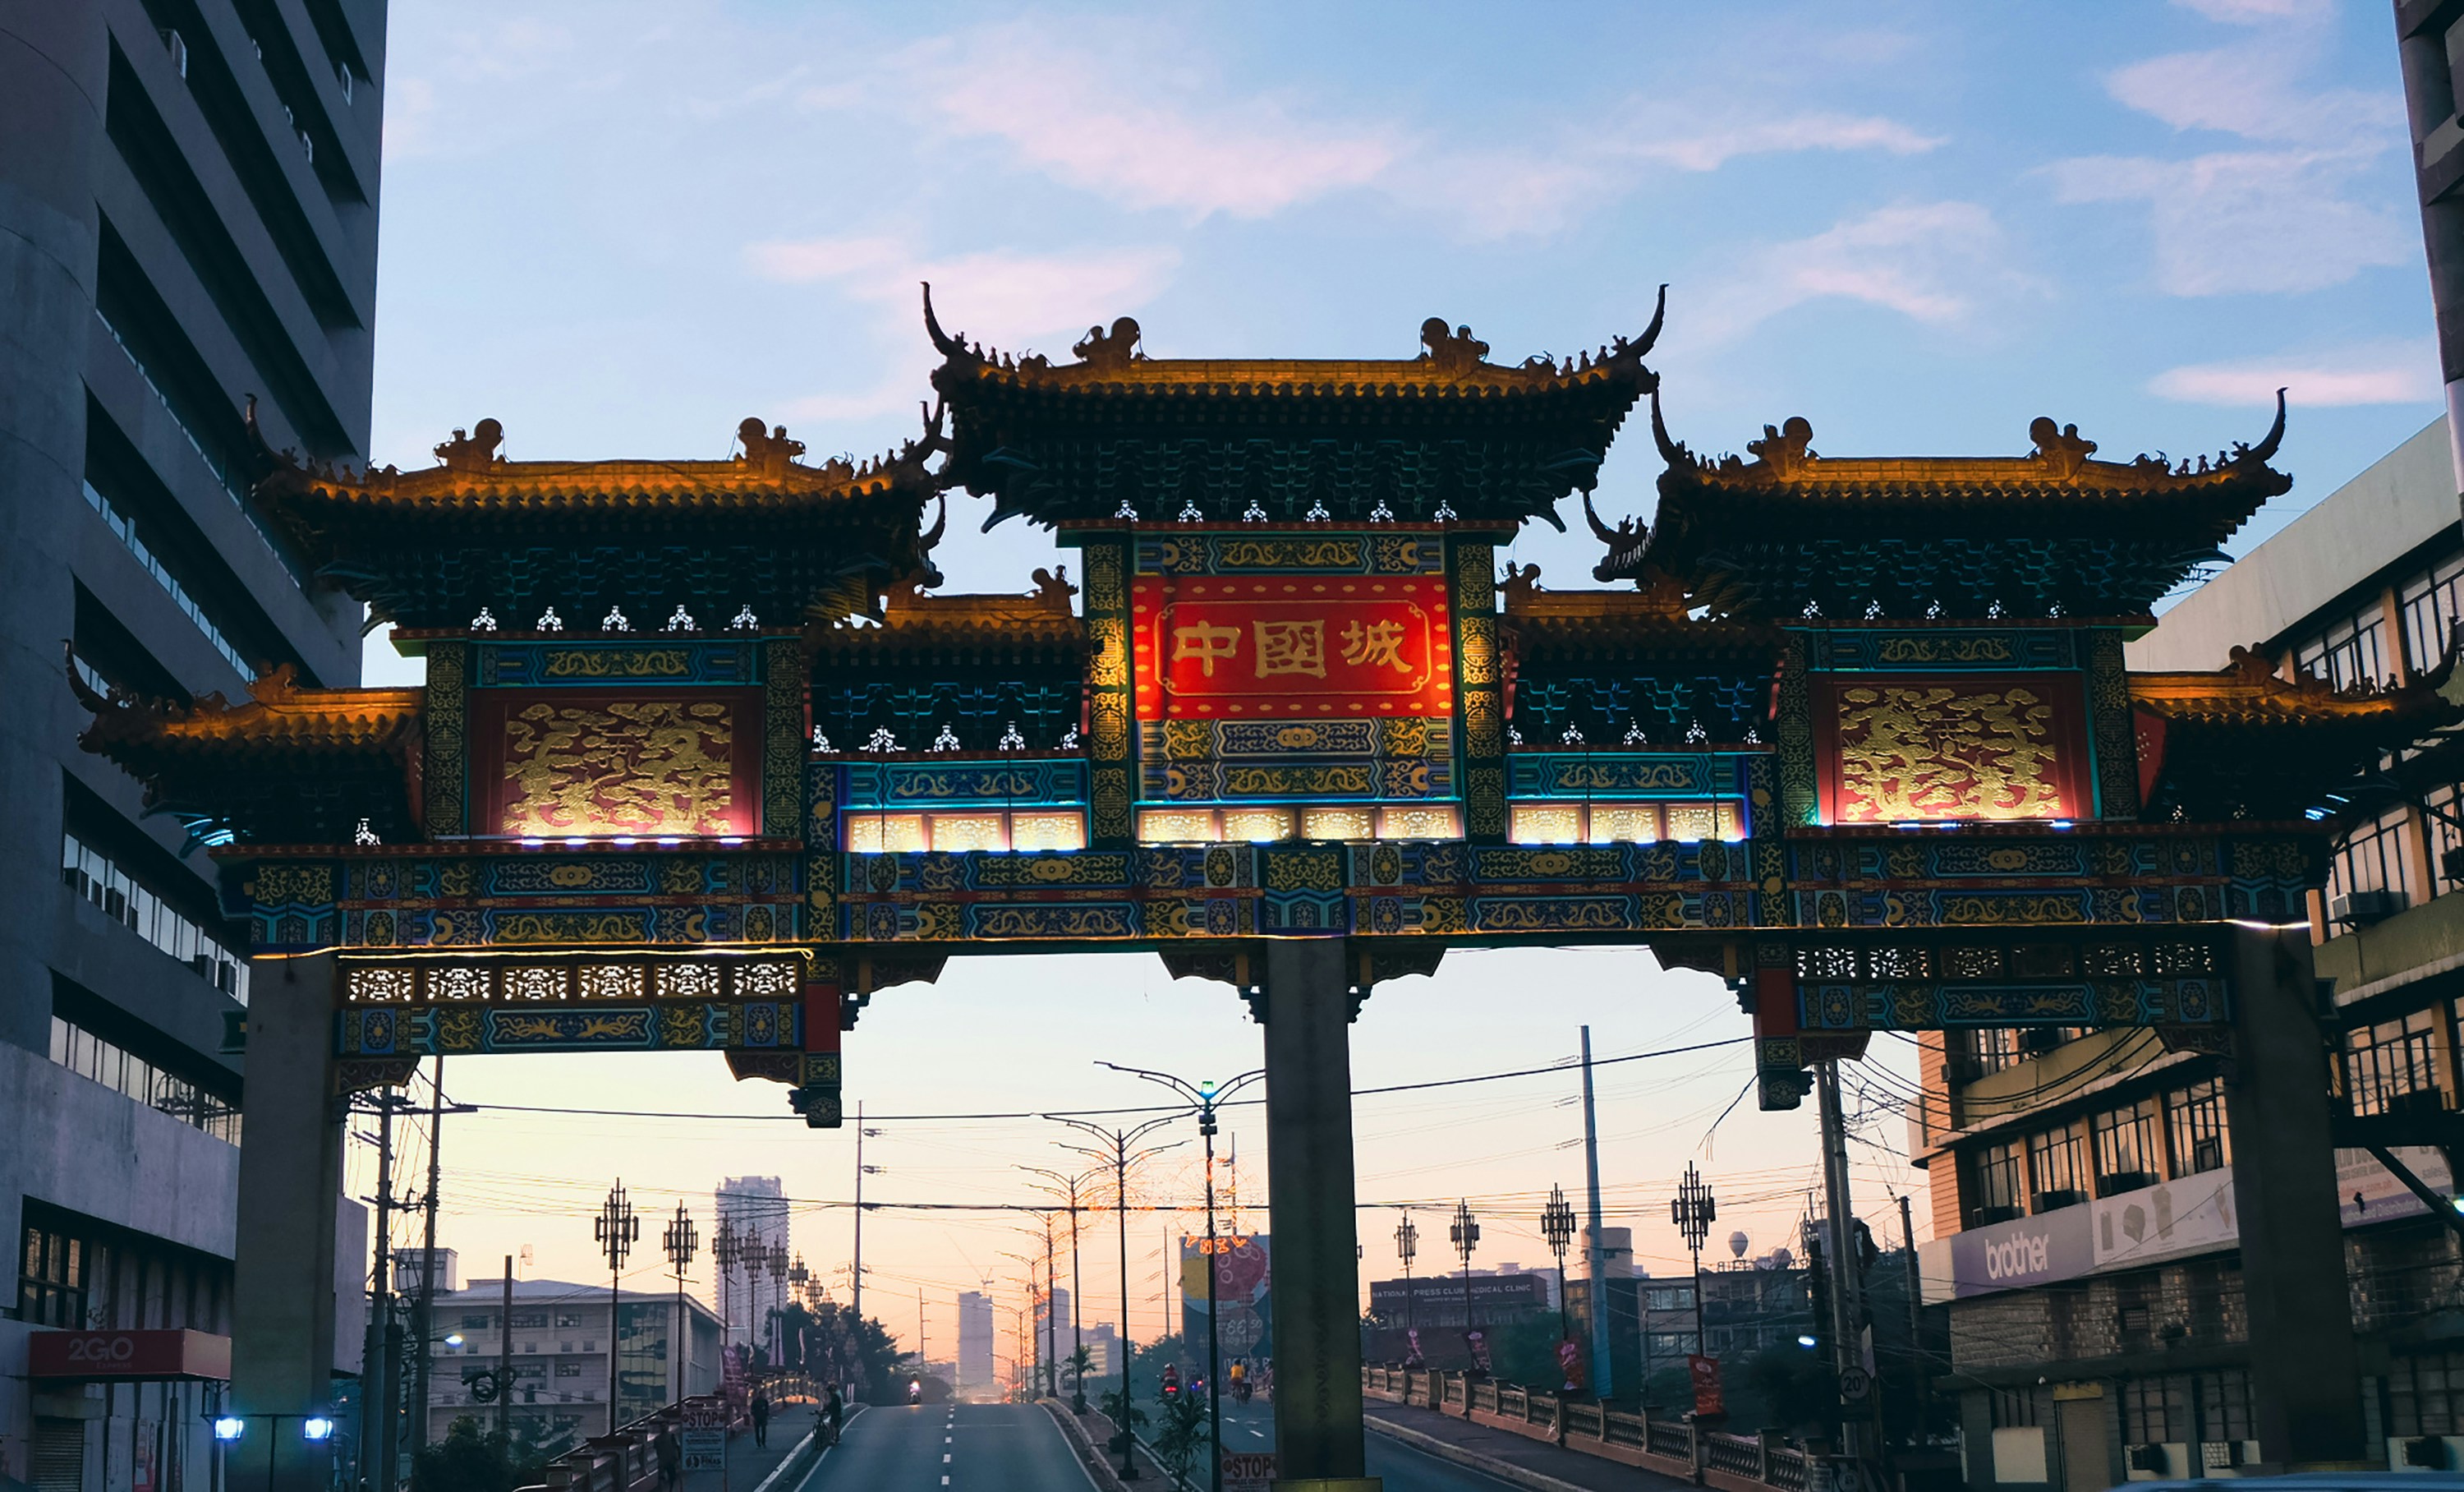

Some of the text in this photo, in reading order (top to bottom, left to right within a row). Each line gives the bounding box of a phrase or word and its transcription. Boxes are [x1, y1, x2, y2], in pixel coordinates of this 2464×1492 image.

[1171, 618, 1414, 679] 中國城
[1985, 1232, 2049, 1279] brother
[1414, 1288, 1441, 1296] PRESS
[1443, 1287, 1465, 1295] CLUB
[1506, 1284, 1532, 1292] CLINIC
[67, 1337, 134, 1361] 2GO
[689, 1411, 717, 1427] STOP
[1232, 1457, 1271, 1478] STOP
